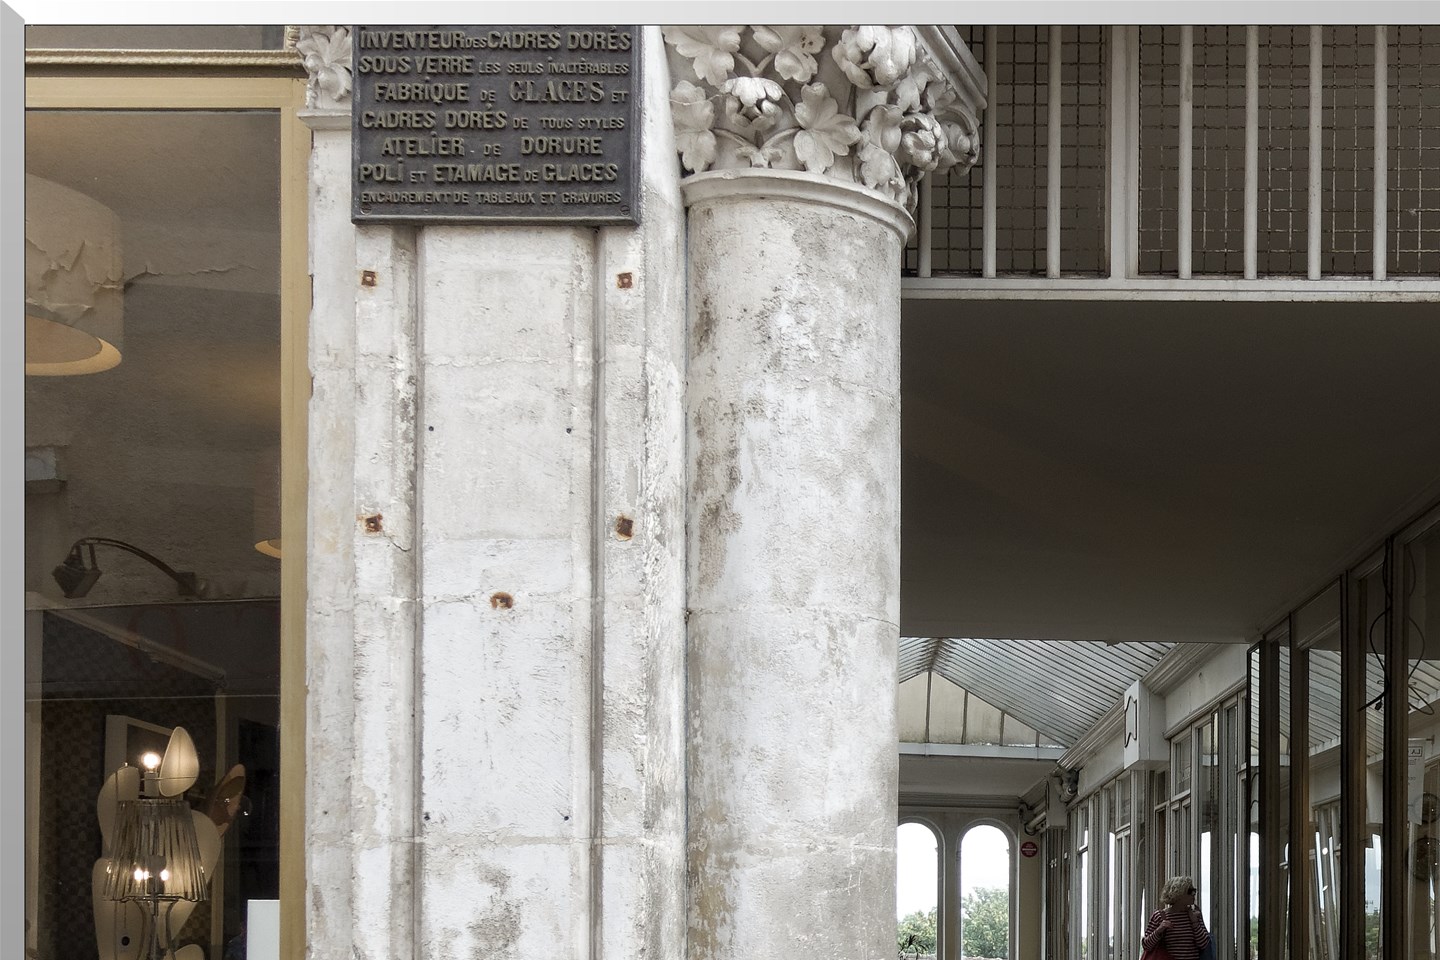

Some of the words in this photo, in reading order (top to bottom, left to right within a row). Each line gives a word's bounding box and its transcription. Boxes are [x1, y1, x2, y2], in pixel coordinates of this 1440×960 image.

[360, 31, 465, 49] INVENTEUR
[465, 36, 487, 48] DES
[487, 31, 561, 49] CADRES
[359, 55, 411, 74] SOUS
[414, 55, 474, 74] VERRE
[478, 61, 501, 74] LES
[507, 62, 543, 74] SEULS
[374, 76, 470, 105] FABRIQUE
[480, 89, 496, 101] DE
[509, 80, 605, 102] GLACES
[611, 90, 629, 102] ET
[361, 110, 436, 129] CADRES
[512, 118, 528, 129] DE
[540, 117, 573, 129] TOUS
[578, 117, 625, 129] STYLES
[381, 131, 465, 156] ATELIER
[483, 144, 501, 156] DE
[521, 136, 604, 156] DORURE
[359, 158, 404, 183] POLI
[410, 170, 427, 183] ET
[432, 163, 521, 183] ETAMAGE
[524, 169, 539, 182] DE
[541, 163, 619, 183] GLACES
[361, 191, 451, 204] ENCADREMENT
[453, 191, 470, 204] DE
[475, 191, 536, 204] TABLEAUX
[541, 191, 557, 204] ET
[561, 191, 622, 205] GRAVURES
